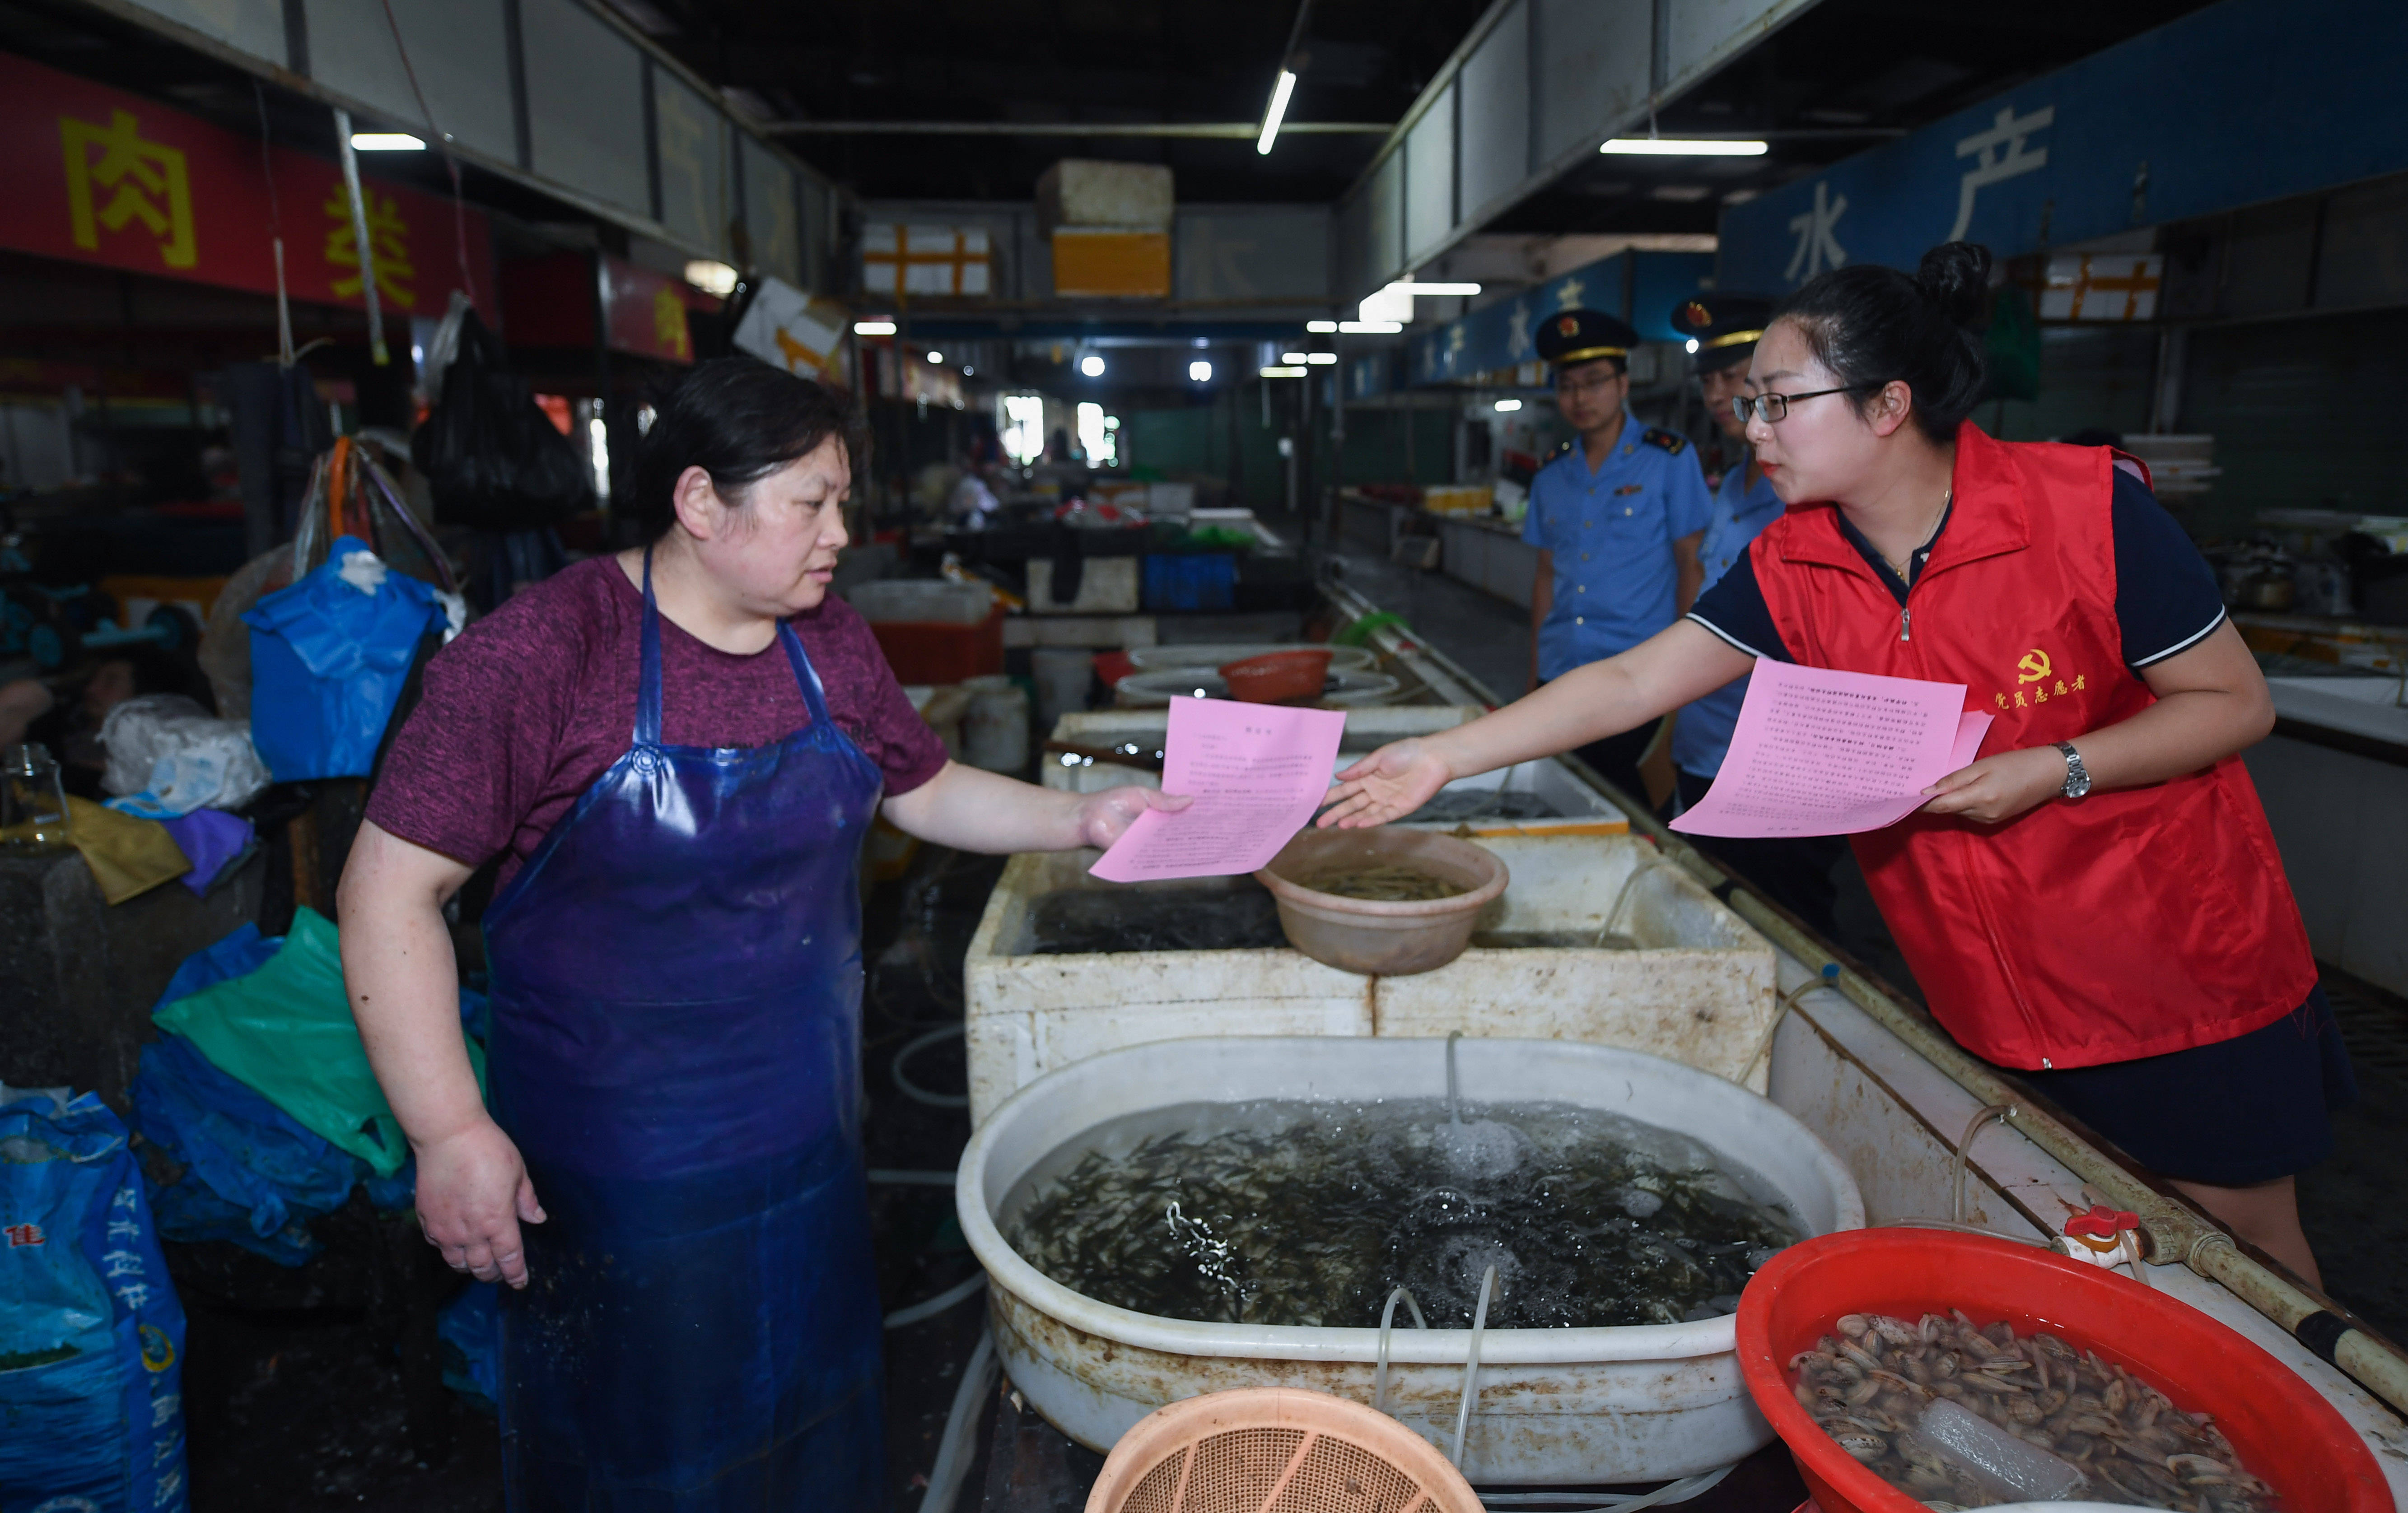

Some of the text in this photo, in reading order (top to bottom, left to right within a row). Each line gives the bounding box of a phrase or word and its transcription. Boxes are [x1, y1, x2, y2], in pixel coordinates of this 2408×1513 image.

[60, 109, 416, 307] 肉类
[1783, 106, 2055, 285] 水产
[1995, 674, 2085, 710] 党员志愿者
